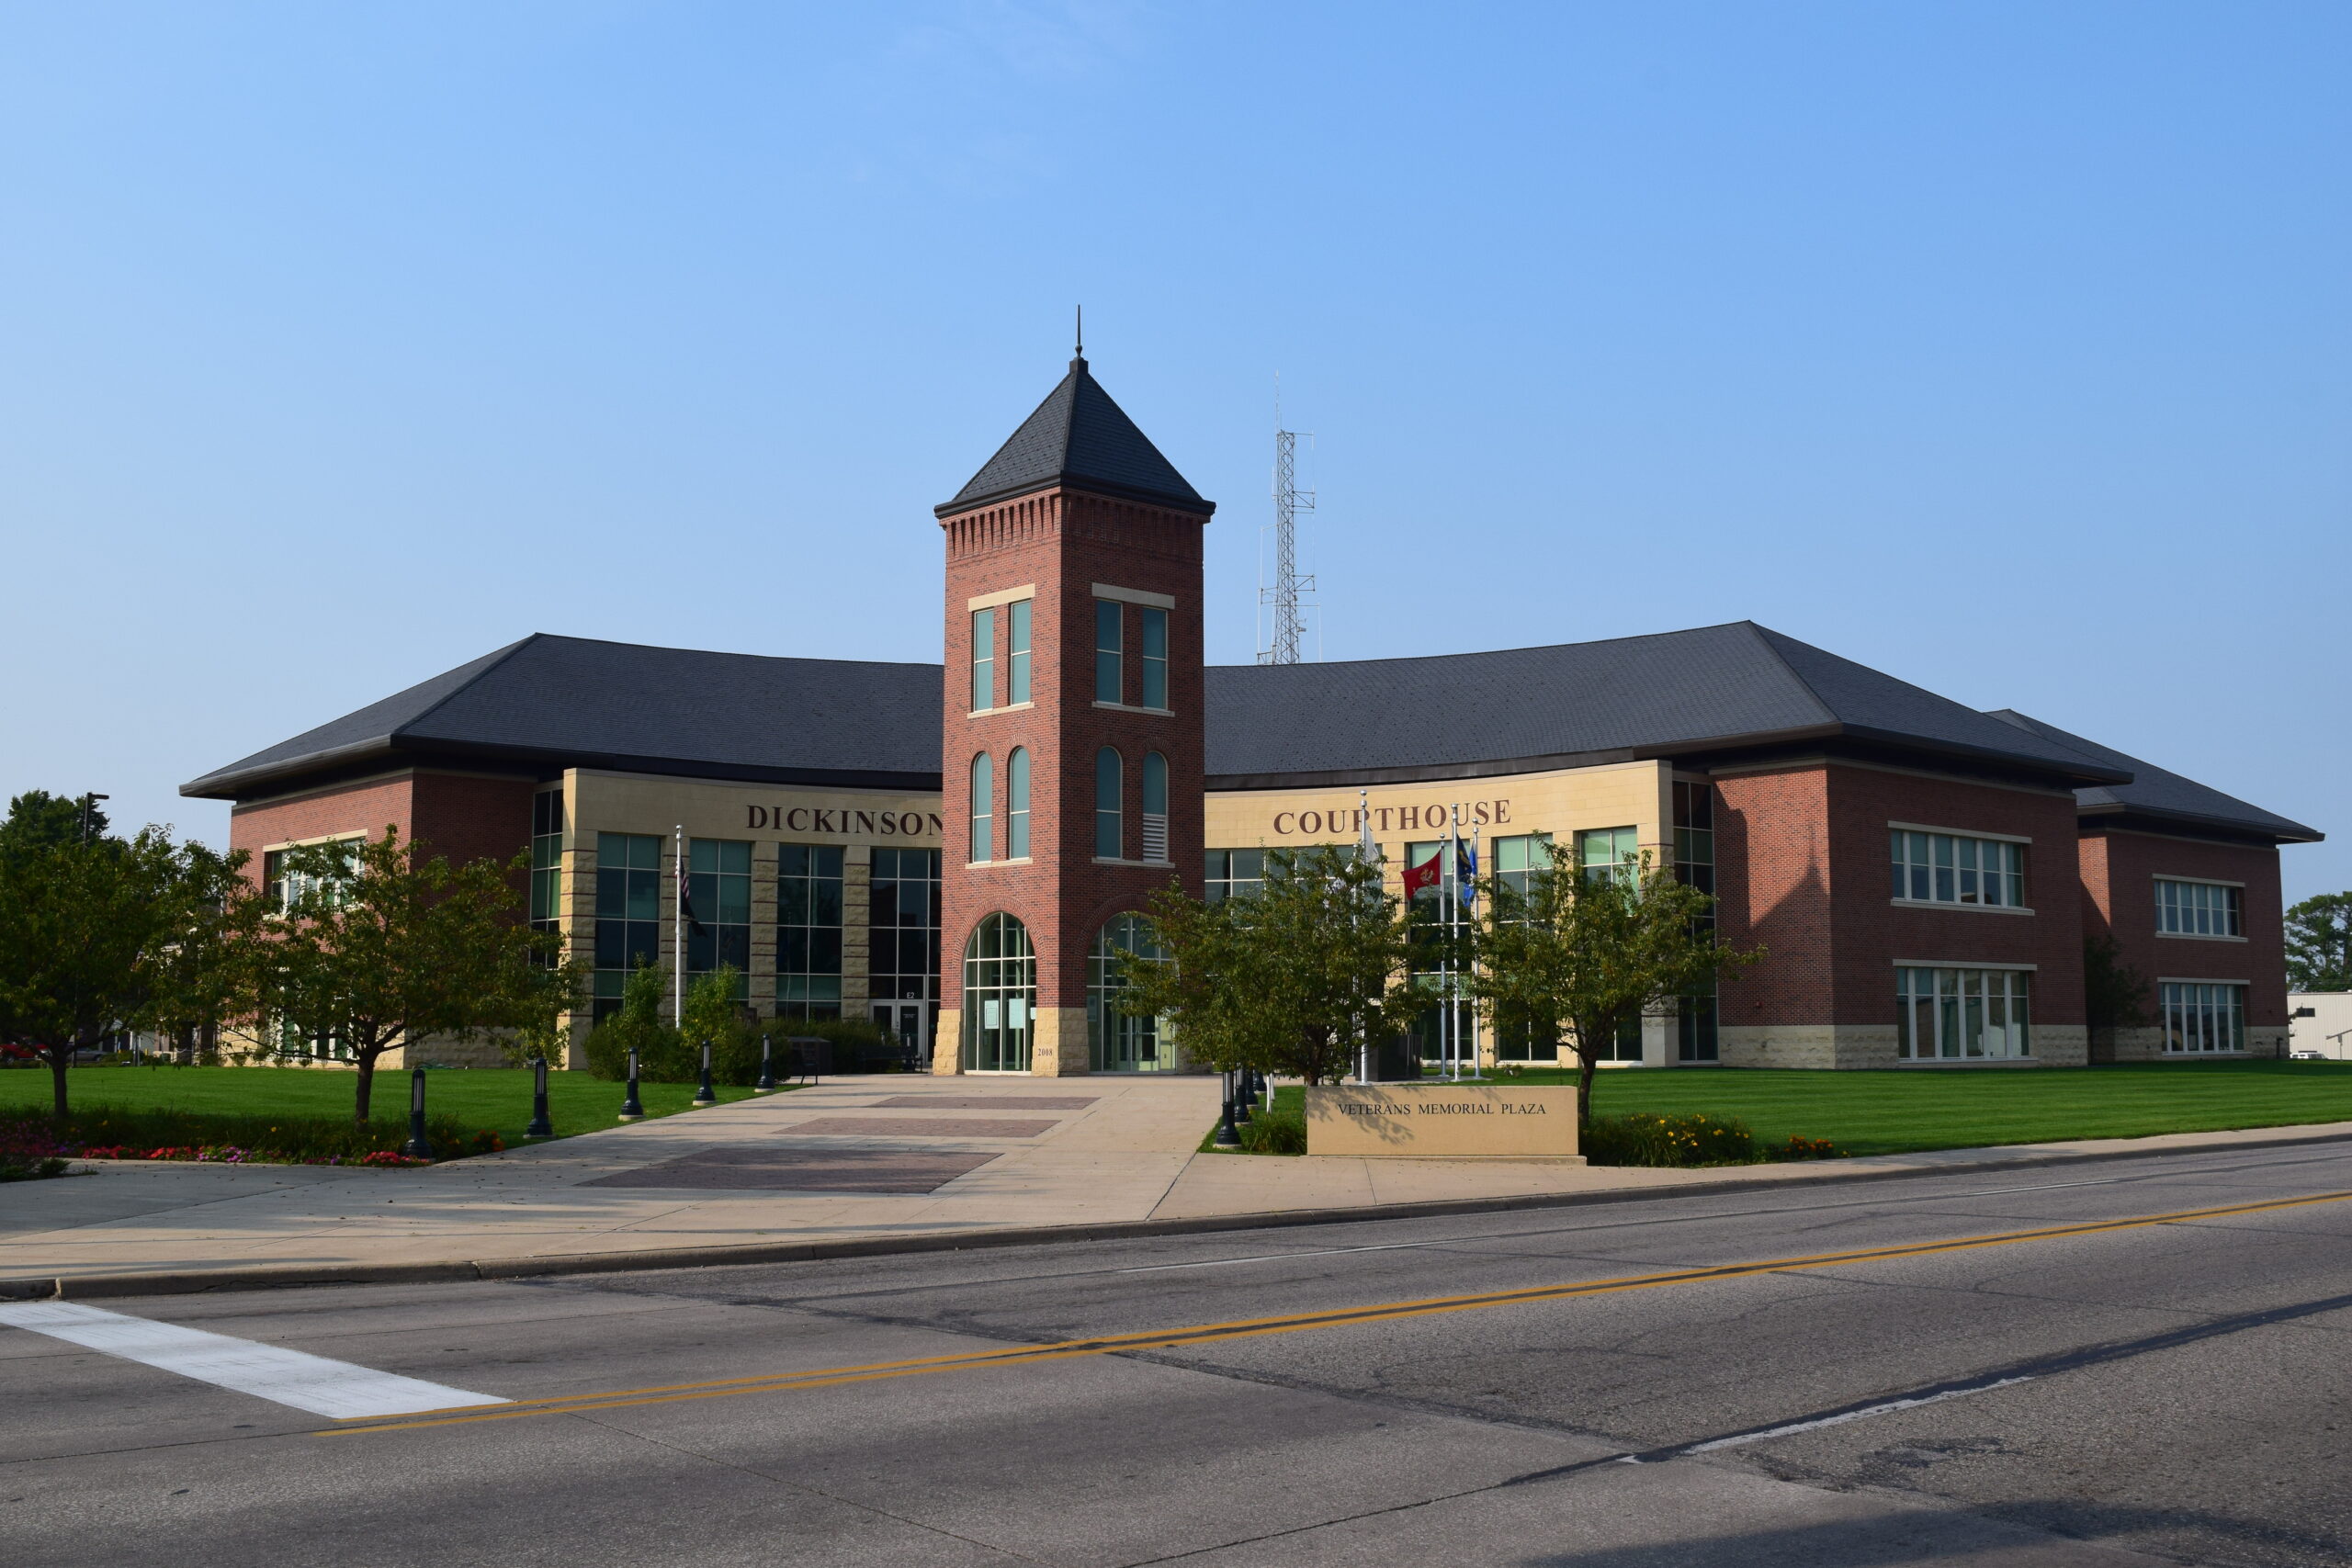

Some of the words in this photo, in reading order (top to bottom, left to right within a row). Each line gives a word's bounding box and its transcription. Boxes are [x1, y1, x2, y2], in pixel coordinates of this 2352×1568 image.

[746, 805, 944, 836] DICKINSON
[1273, 799, 1511, 835] COURTHOUSE
[1037, 1048, 1053, 1056] 2008
[1338, 1103, 1411, 1115] VETERANS
[1418, 1103, 1494, 1115] MEMORIAL
[1501, 1103, 1546, 1115] PLAZA
